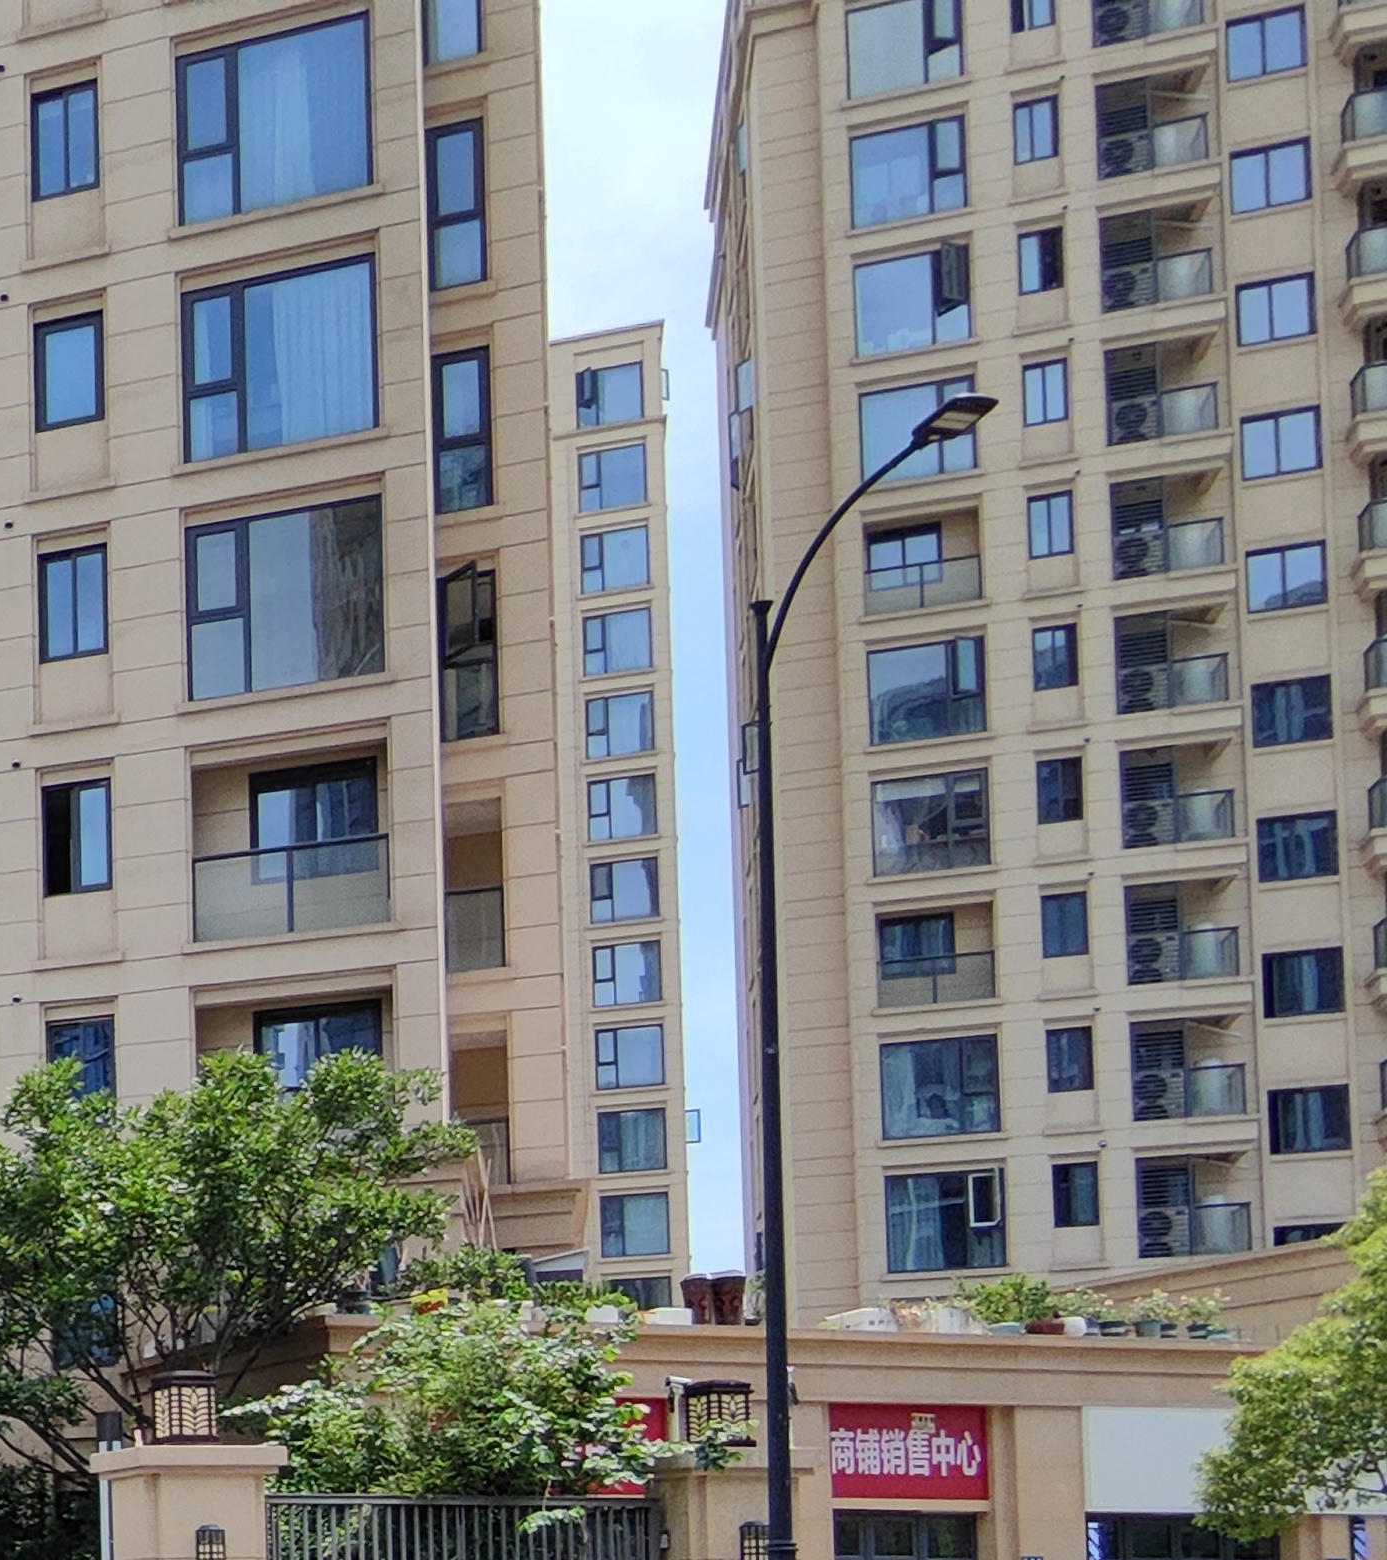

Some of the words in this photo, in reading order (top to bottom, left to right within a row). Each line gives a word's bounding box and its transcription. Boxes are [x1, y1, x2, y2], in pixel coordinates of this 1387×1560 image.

[829, 1427, 982, 1477] 商铺销售中心
